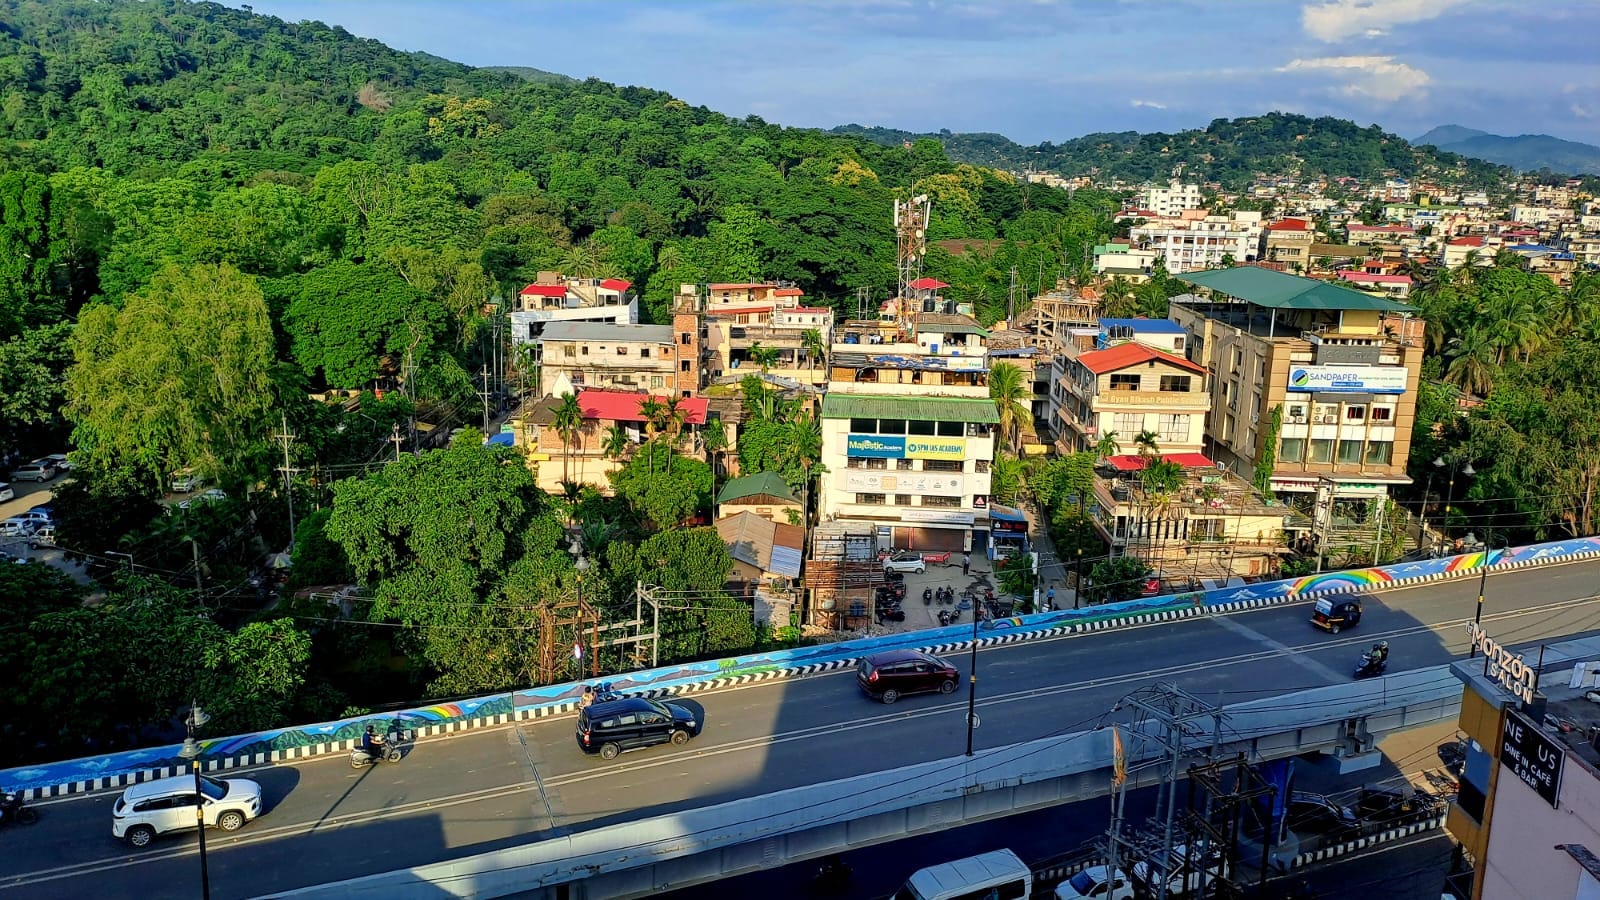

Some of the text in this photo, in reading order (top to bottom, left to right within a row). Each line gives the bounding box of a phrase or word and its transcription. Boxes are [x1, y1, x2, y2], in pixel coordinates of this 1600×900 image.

[1309, 373, 1358, 382] SANDPAPER
[849, 440, 883, 450] Majestic
[939, 445, 962, 453] ACADEMY
[1490, 662, 1533, 705] SALON
[1504, 741, 1521, 761] DINE
[1521, 755, 1529, 769] IN
[1520, 769, 1538, 789] BAR
